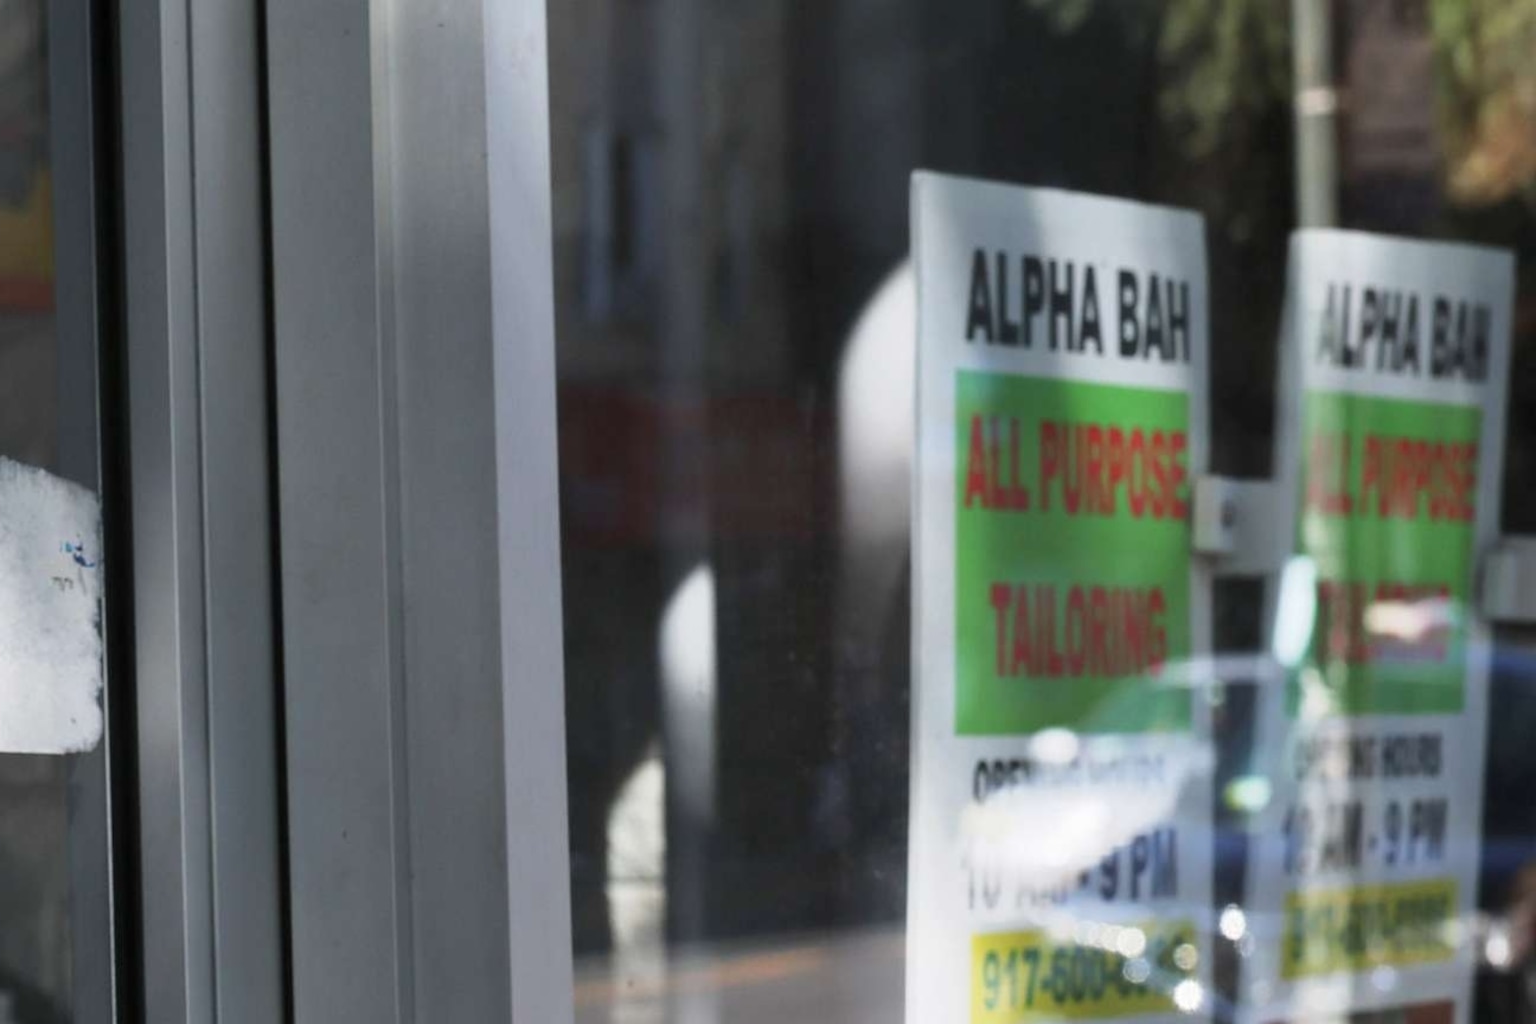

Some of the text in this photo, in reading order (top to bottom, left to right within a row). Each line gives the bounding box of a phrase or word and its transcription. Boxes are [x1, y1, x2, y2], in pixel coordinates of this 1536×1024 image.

[966, 247, 1193, 362] ALPHA BAH
[1318, 280, 1421, 378] ALPHA
[964, 413, 1188, 521] ALL PURPOSE
[1361, 432, 1478, 524] PURPOSE
[990, 581, 1168, 680] TAILORING
